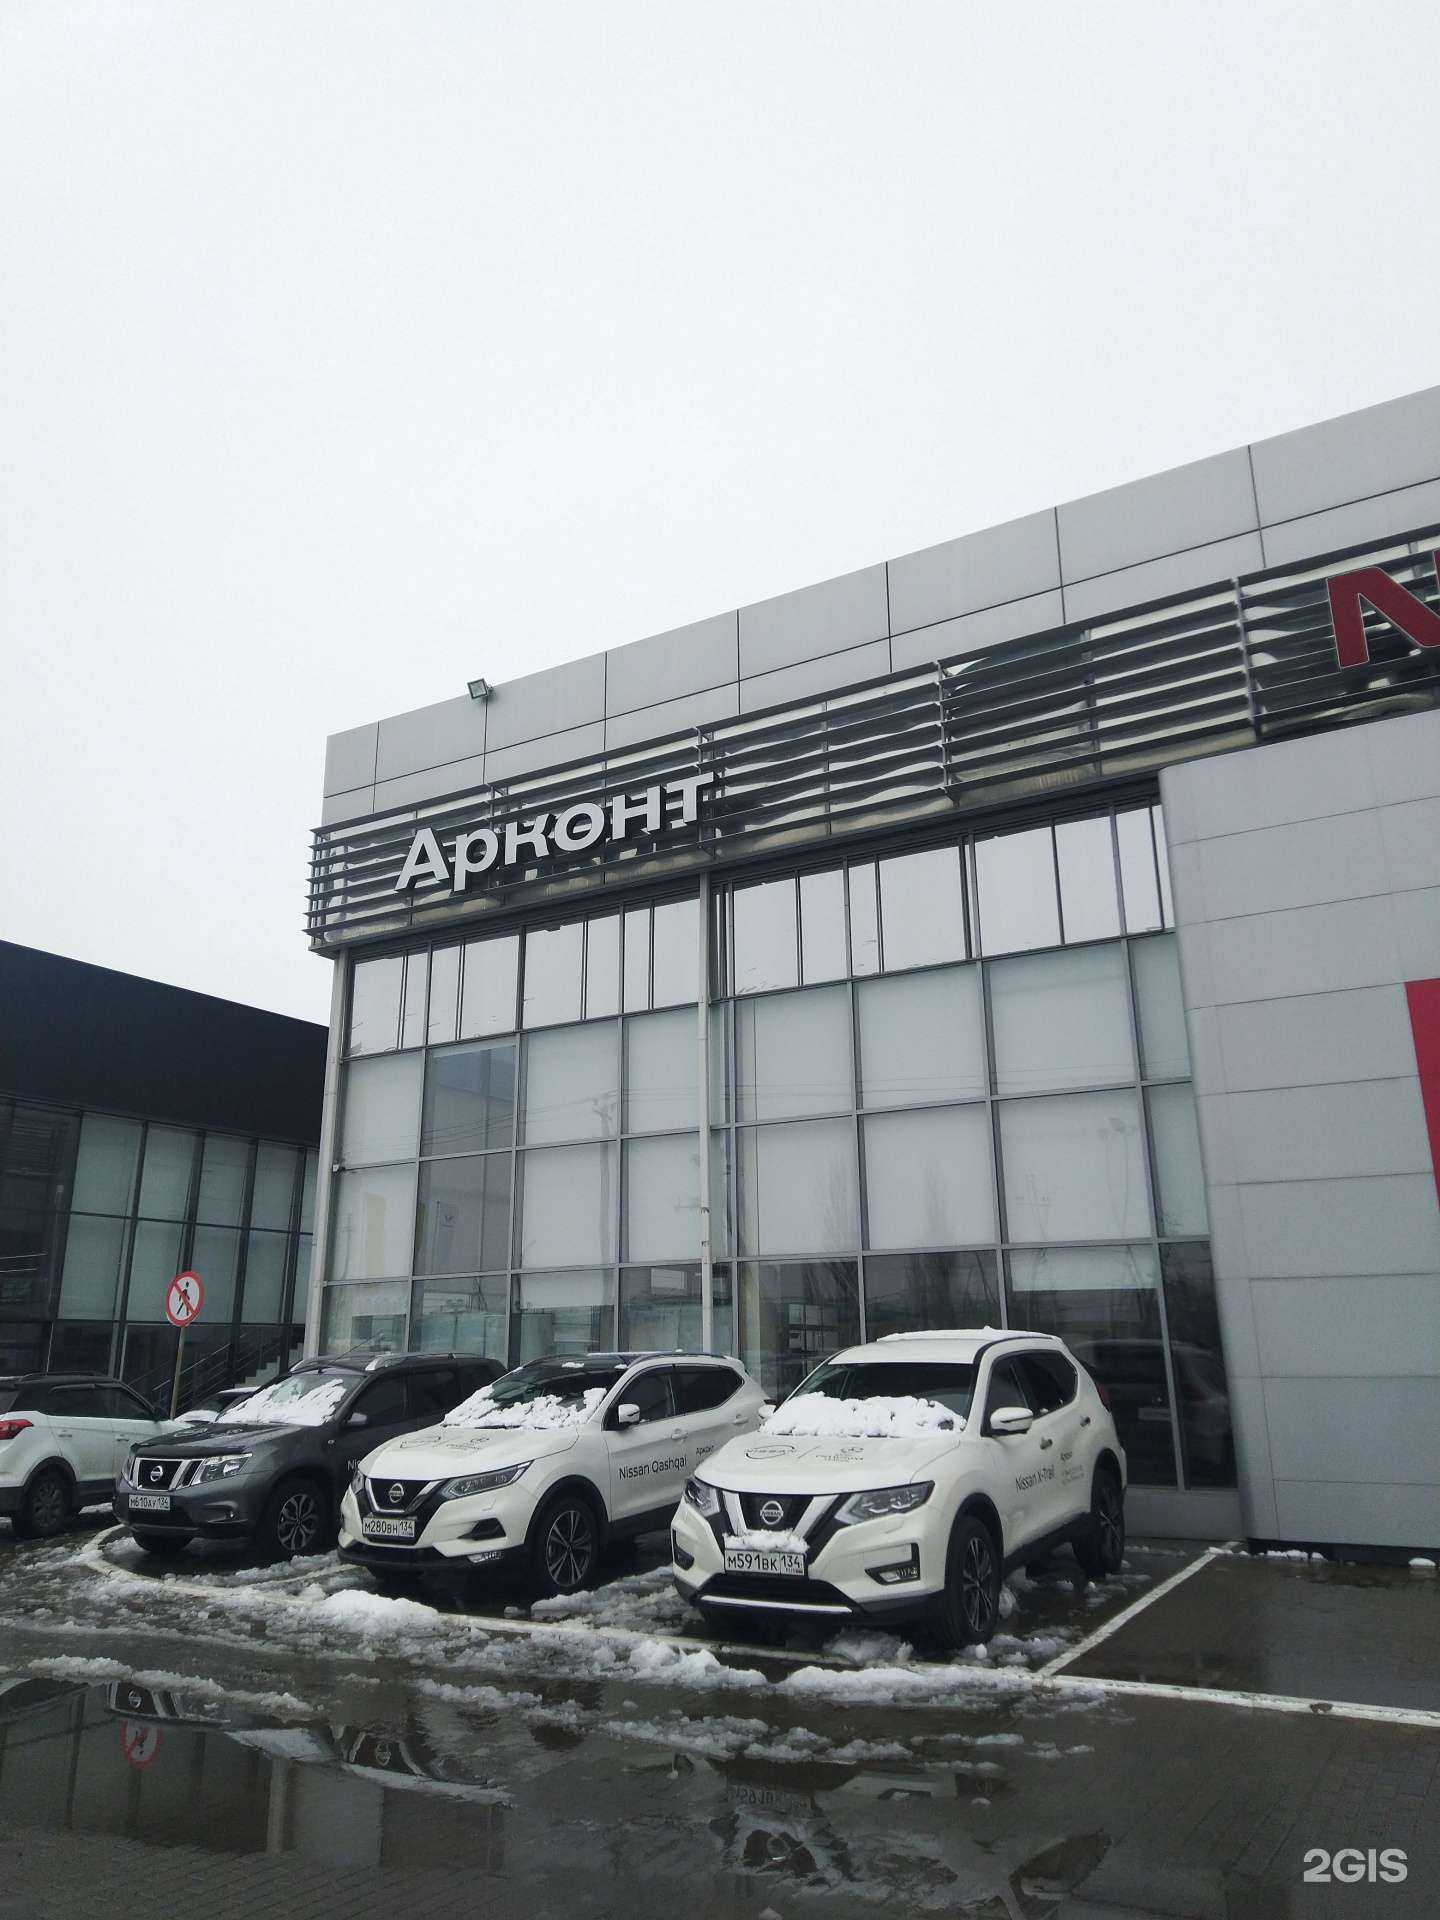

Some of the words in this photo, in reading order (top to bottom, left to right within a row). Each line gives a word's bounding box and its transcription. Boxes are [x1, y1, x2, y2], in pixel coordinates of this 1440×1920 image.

[393, 772, 715, 892] Арконт
[619, 1462, 650, 1480] Nissan
[651, 1455, 687, 1474] Qashqai
[781, 1554, 801, 1568] 134
